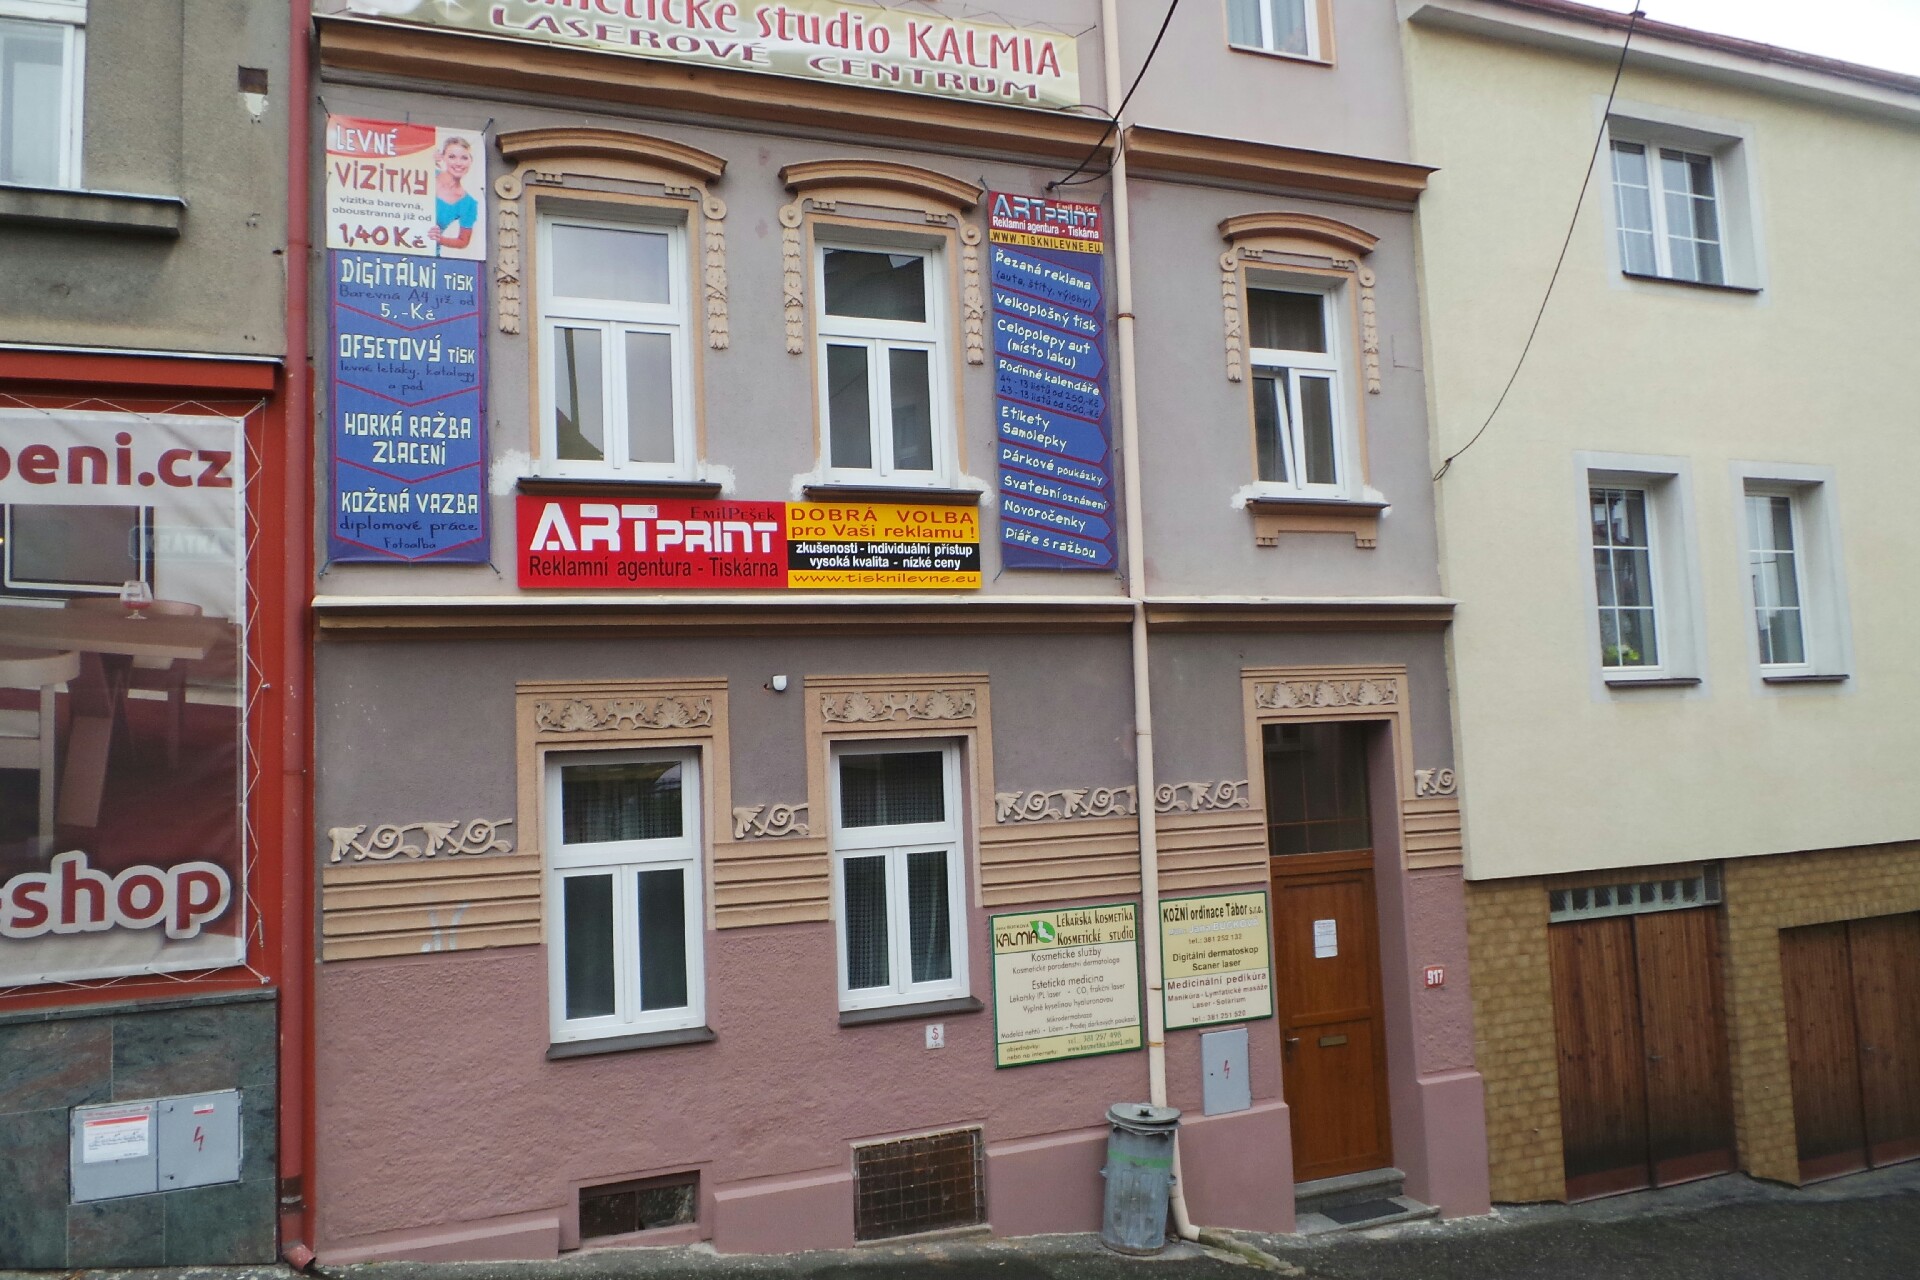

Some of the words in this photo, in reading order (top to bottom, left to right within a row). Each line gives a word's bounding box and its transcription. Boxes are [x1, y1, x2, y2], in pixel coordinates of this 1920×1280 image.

[492, 8, 770, 64] LASEROVÉ
[809, 56, 1038, 100] CENTRUM
[755, 6, 890, 55] studio
[907, 21, 1062, 79] KALMIA
[336, 123, 398, 156] LEVNÉ
[340, 196, 374, 206] vizitka
[418, 214, 432, 222] od
[1027, 222, 1059, 235] agentura
[339, 223, 389, 247] 1,40
[393, 226, 427, 248] Kč
[1044, 270, 1092, 291] reklama
[408, 288, 429, 303] A4
[460, 295, 475, 306] od
[996, 293, 1070, 327] Velkoplošný
[1073, 314, 1096, 332] tisk
[340, 333, 442, 362] OFSETOVÝ
[998, 319, 1066, 351] Celopolepy
[1068, 341, 1091, 355] aut
[1008, 338, 1044, 358] (místo
[1047, 349, 1076, 369] laku)
[402, 381, 424, 395] pod
[999, 359, 1042, 380] Rodinné
[1045, 372, 1100, 396] kalendáře
[1020, 379, 1029, 389] 13
[1052, 389, 1064, 398] od
[1020, 389, 1029, 399] 13
[1053, 399, 1064, 408] od
[344, 411, 403, 438] HORKÁ
[409, 412, 471, 439] RAŽBA
[1002, 406, 1050, 432] Etikety
[1003, 423, 1067, 452] Samolepky
[0, 432, 233, 488] eni.cz
[1003, 449, 1055, 471] Dárkové
[1057, 465, 1103, 486] poukázky
[1004, 476, 1061, 499] Svatební
[341, 486, 410, 514] KOŽENÁ
[416, 493, 478, 515] VAZBA
[339, 515, 422, 538] diplomové
[429, 518, 478, 538] práce
[791, 506, 878, 522] DOBRÁ
[896, 510, 974, 525] VOLBA
[1005, 500, 1086, 532] Novoročenky
[791, 525, 826, 539] pro
[833, 524, 876, 537] Vaši
[884, 525, 963, 539] reklamu
[1006, 527, 1039, 545] Diáře
[1043, 539, 1050, 548] s
[1052, 540, 1096, 559] ražbou
[384, 537, 437, 550] Fotoalba
[796, 541, 858, 554] zkušenosti
[867, 542, 931, 555] individuální
[934, 544, 973, 557] přístup
[529, 555, 608, 577] Reklamní
[617, 559, 692, 581] agentura
[709, 556, 779, 577] Tiskárna
[810, 555, 850, 570] vysoká
[852, 556, 890, 568] kvalita
[903, 556, 932, 569] nízké
[934, 558, 961, 571] ceny
[793, 573, 977, 584] www.tisknilevne.eu
[1190, 904, 1224, 920] ordinace
[996, 930, 1038, 948] KALMIA
[1208, 946, 1259, 958] dermatoskop
[1192, 962, 1220, 971] Scaner
[1222, 959, 1242, 968] laser
[1427, 969, 1444, 985] 917
